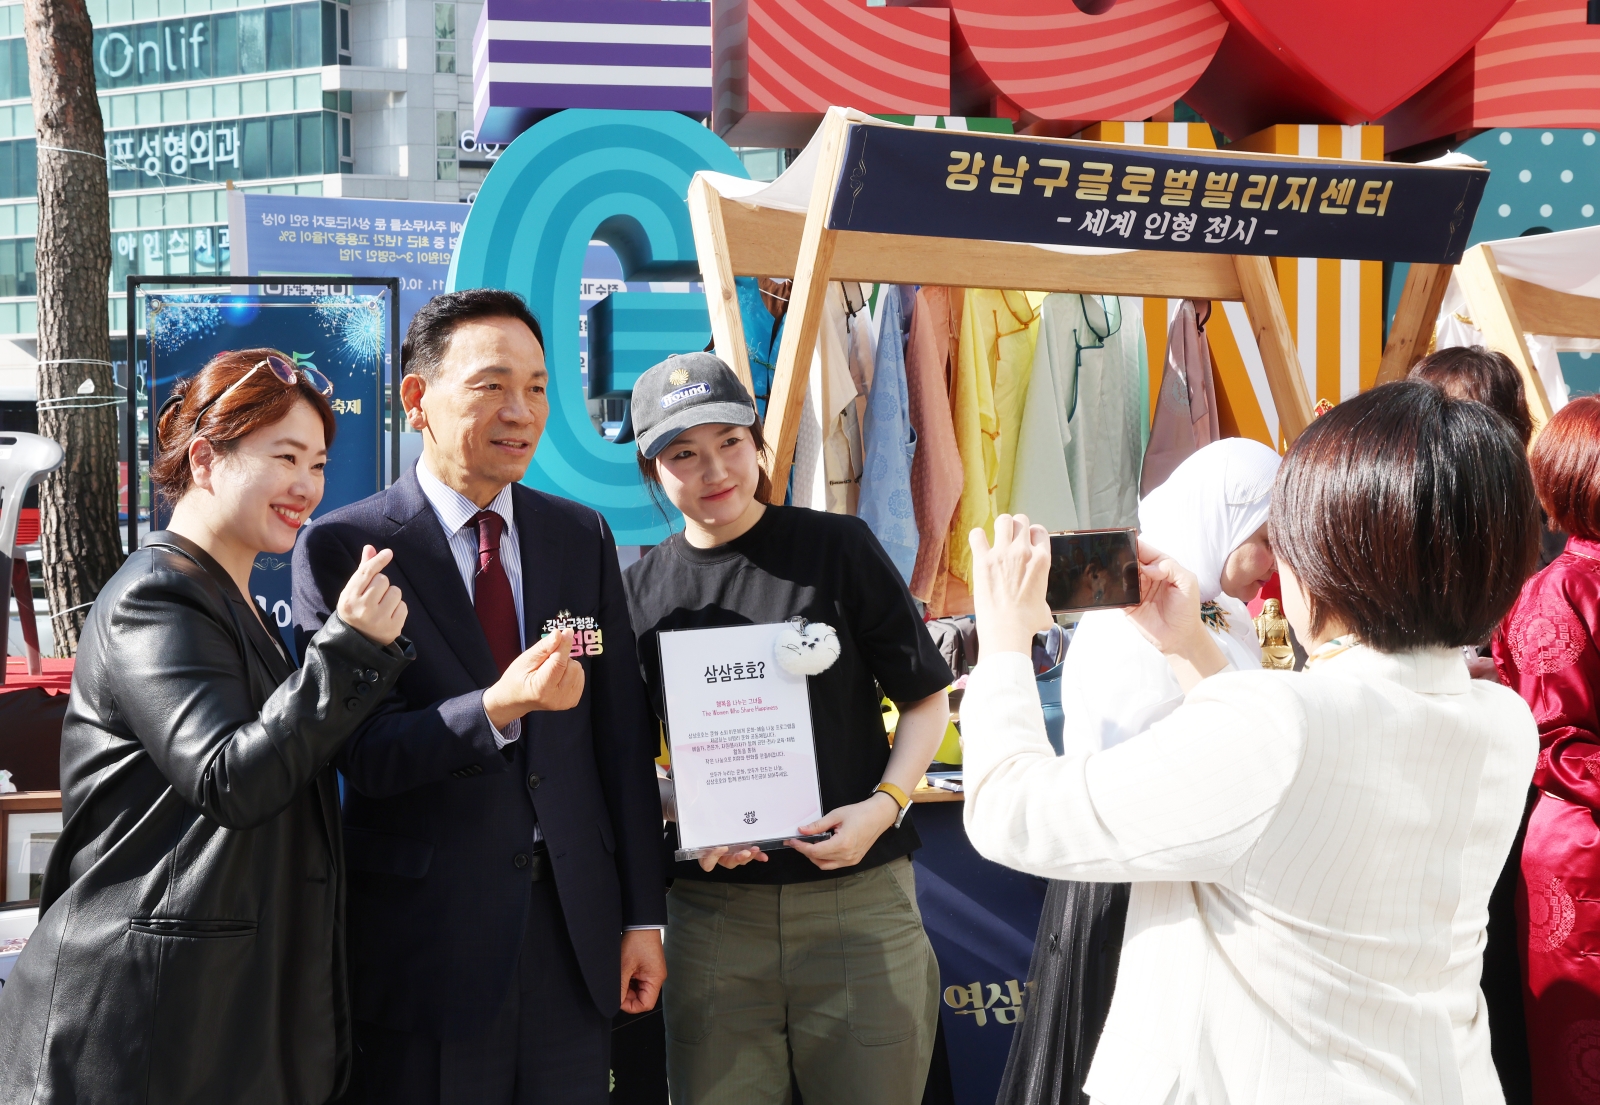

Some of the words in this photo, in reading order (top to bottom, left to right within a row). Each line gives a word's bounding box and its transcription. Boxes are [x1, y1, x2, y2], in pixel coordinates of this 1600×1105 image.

[100, 22, 204, 77] Onlif
[105, 127, 240, 178] 프성형외과
[945, 150, 1393, 217] 강남구글로벌빌리지센터
[1078, 208, 1137, 238] 세계
[1143, 211, 1198, 242] 인형
[1203, 214, 1258, 245] 전시
[546, 616, 594, 632] 강남구청장
[704, 661, 765, 684] 삼삼호호?
